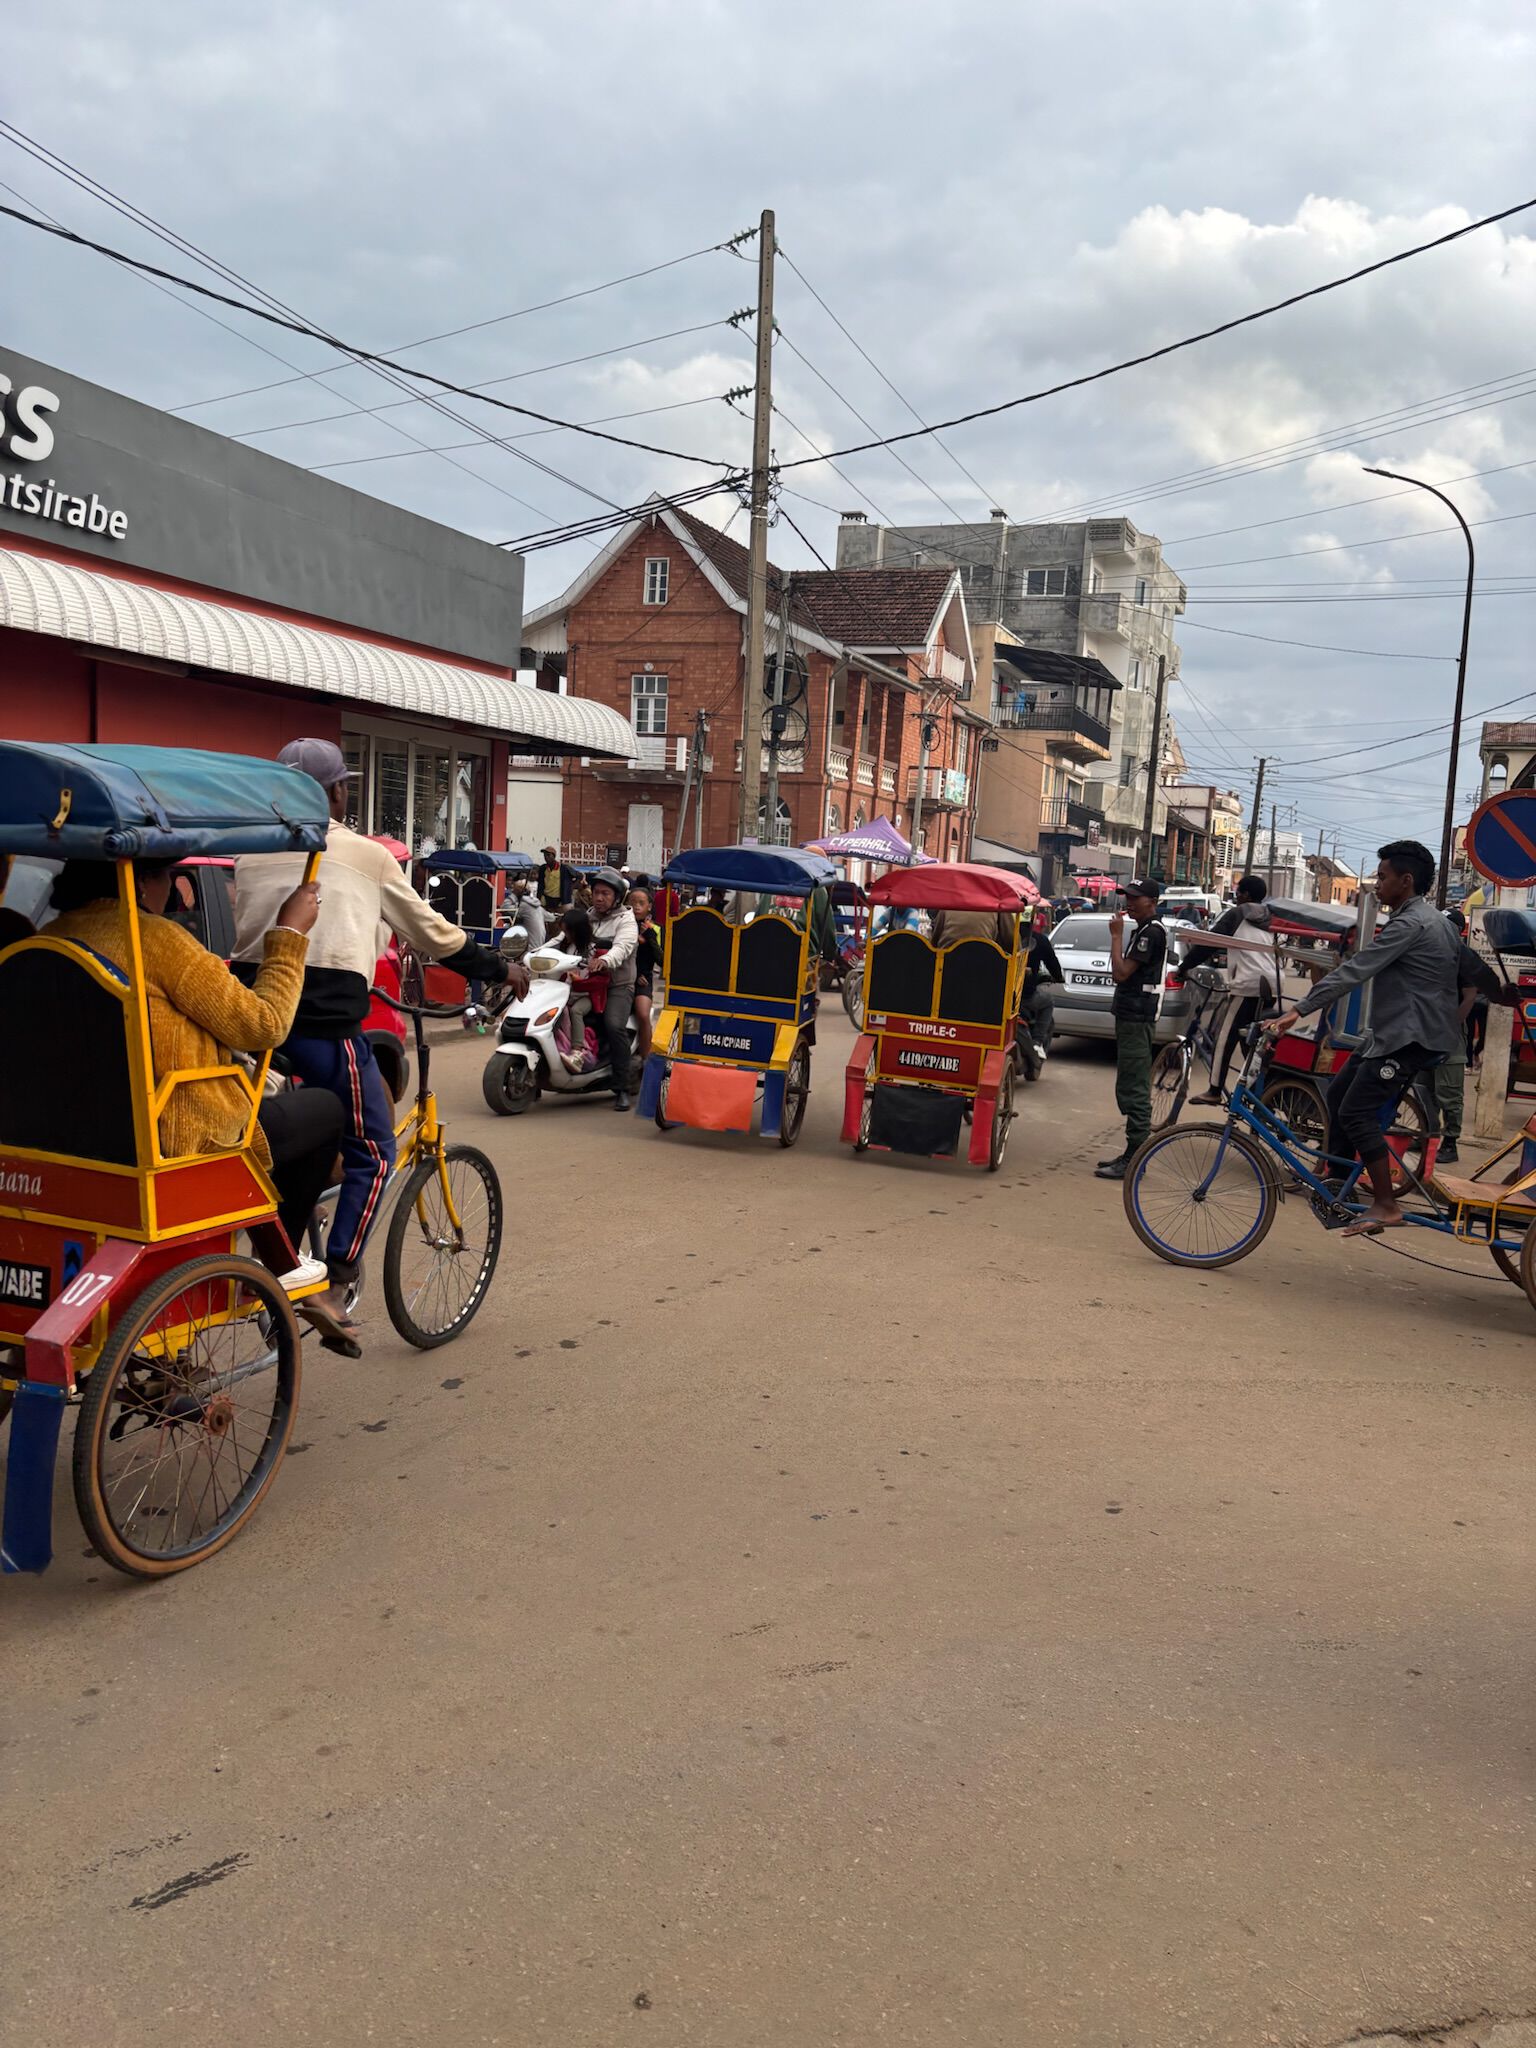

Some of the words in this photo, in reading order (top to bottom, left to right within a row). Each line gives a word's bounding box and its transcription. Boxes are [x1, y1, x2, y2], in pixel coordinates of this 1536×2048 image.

[0, 373, 60, 461] S
[1075, 975, 1097, 984] 037
[1099, 976, 1118, 986] 10
[908, 1021, 957, 1038] TRIPLE-C
[899, 1051, 960, 1072] 4419/CP/ABE
[0, 1264, 43, 1300] /ABE
[61, 1271, 113, 1307] 07
